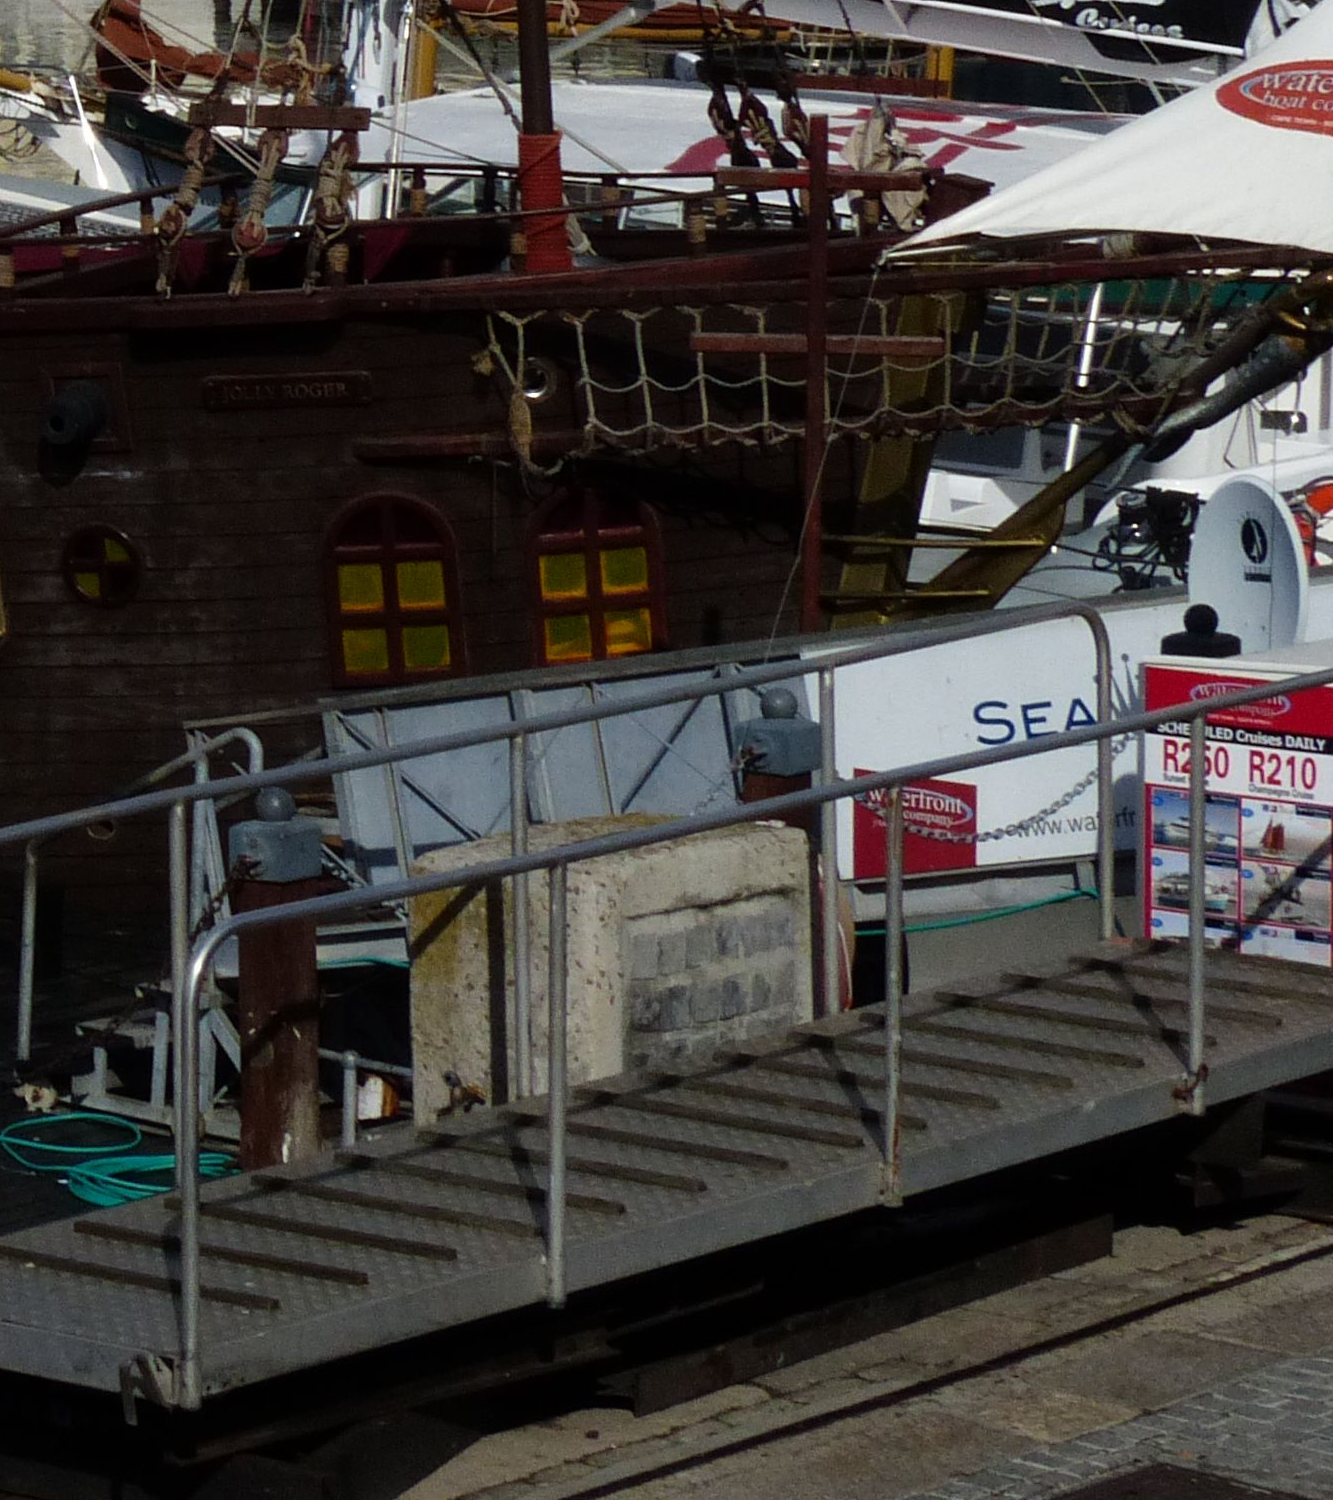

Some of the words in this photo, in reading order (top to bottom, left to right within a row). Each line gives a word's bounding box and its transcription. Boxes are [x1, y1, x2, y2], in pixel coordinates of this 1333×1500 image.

[283, 382, 350, 398] ROGER
[1236, 730, 1282, 746] Cruises
[1285, 734, 1326, 751] DAILY
[1249, 750, 1316, 790] R210
[902, 811, 953, 828] company
